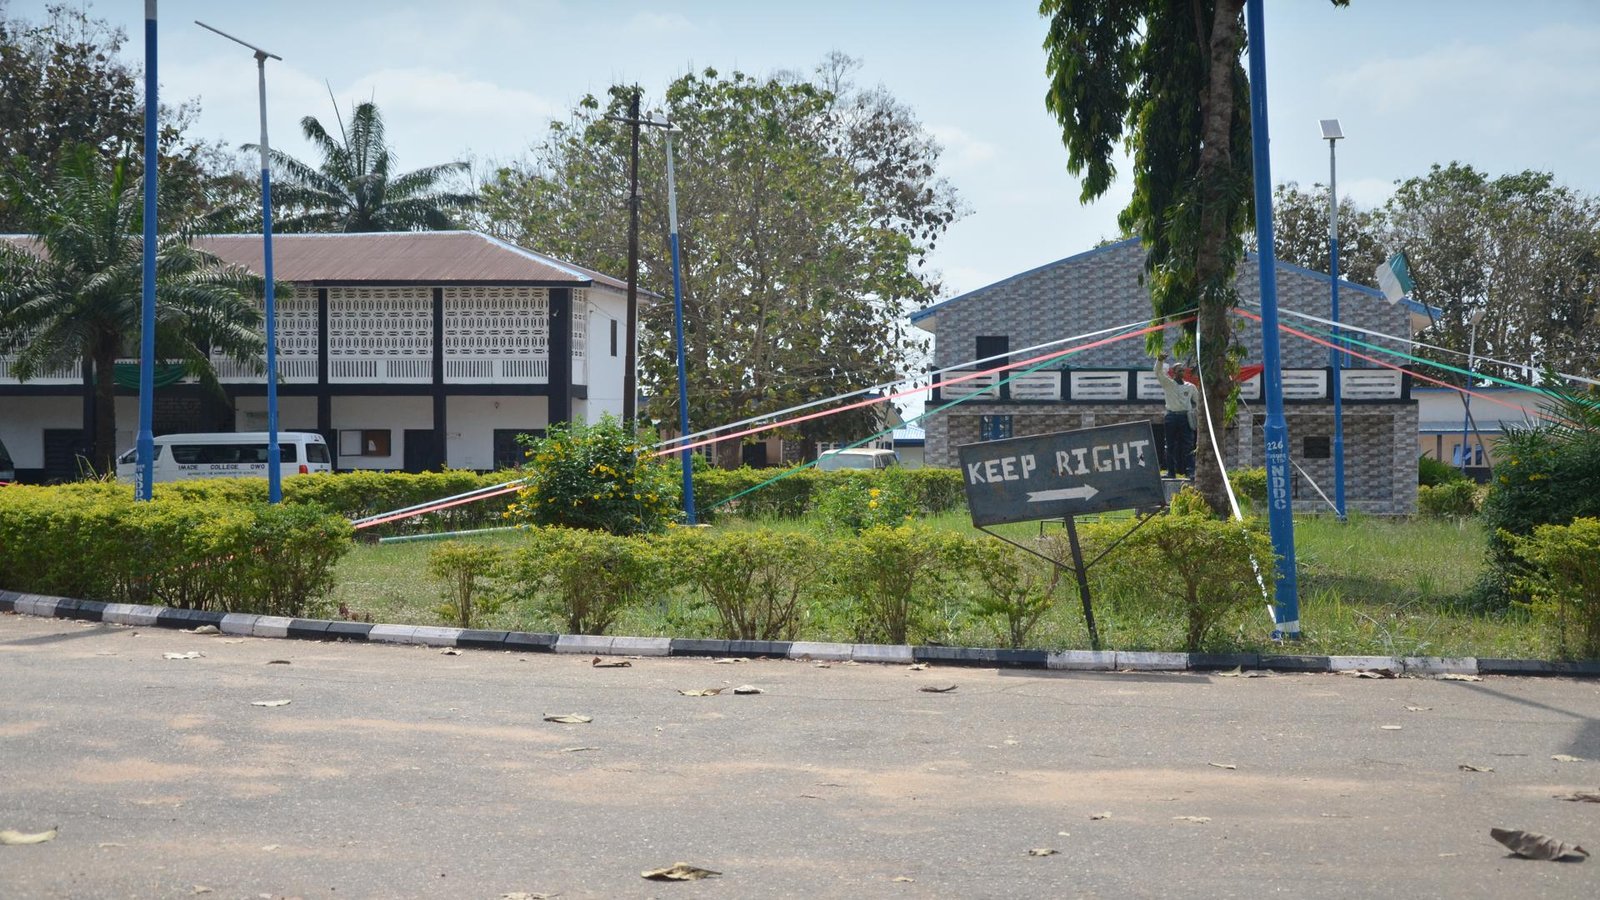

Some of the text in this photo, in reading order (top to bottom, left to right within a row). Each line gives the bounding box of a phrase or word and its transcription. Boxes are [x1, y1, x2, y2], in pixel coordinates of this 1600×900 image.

[967, 440, 1149, 485] KEEP RIGHT
[1267, 441, 1284, 451] 226
[1271, 465, 1287, 510] NDDC
